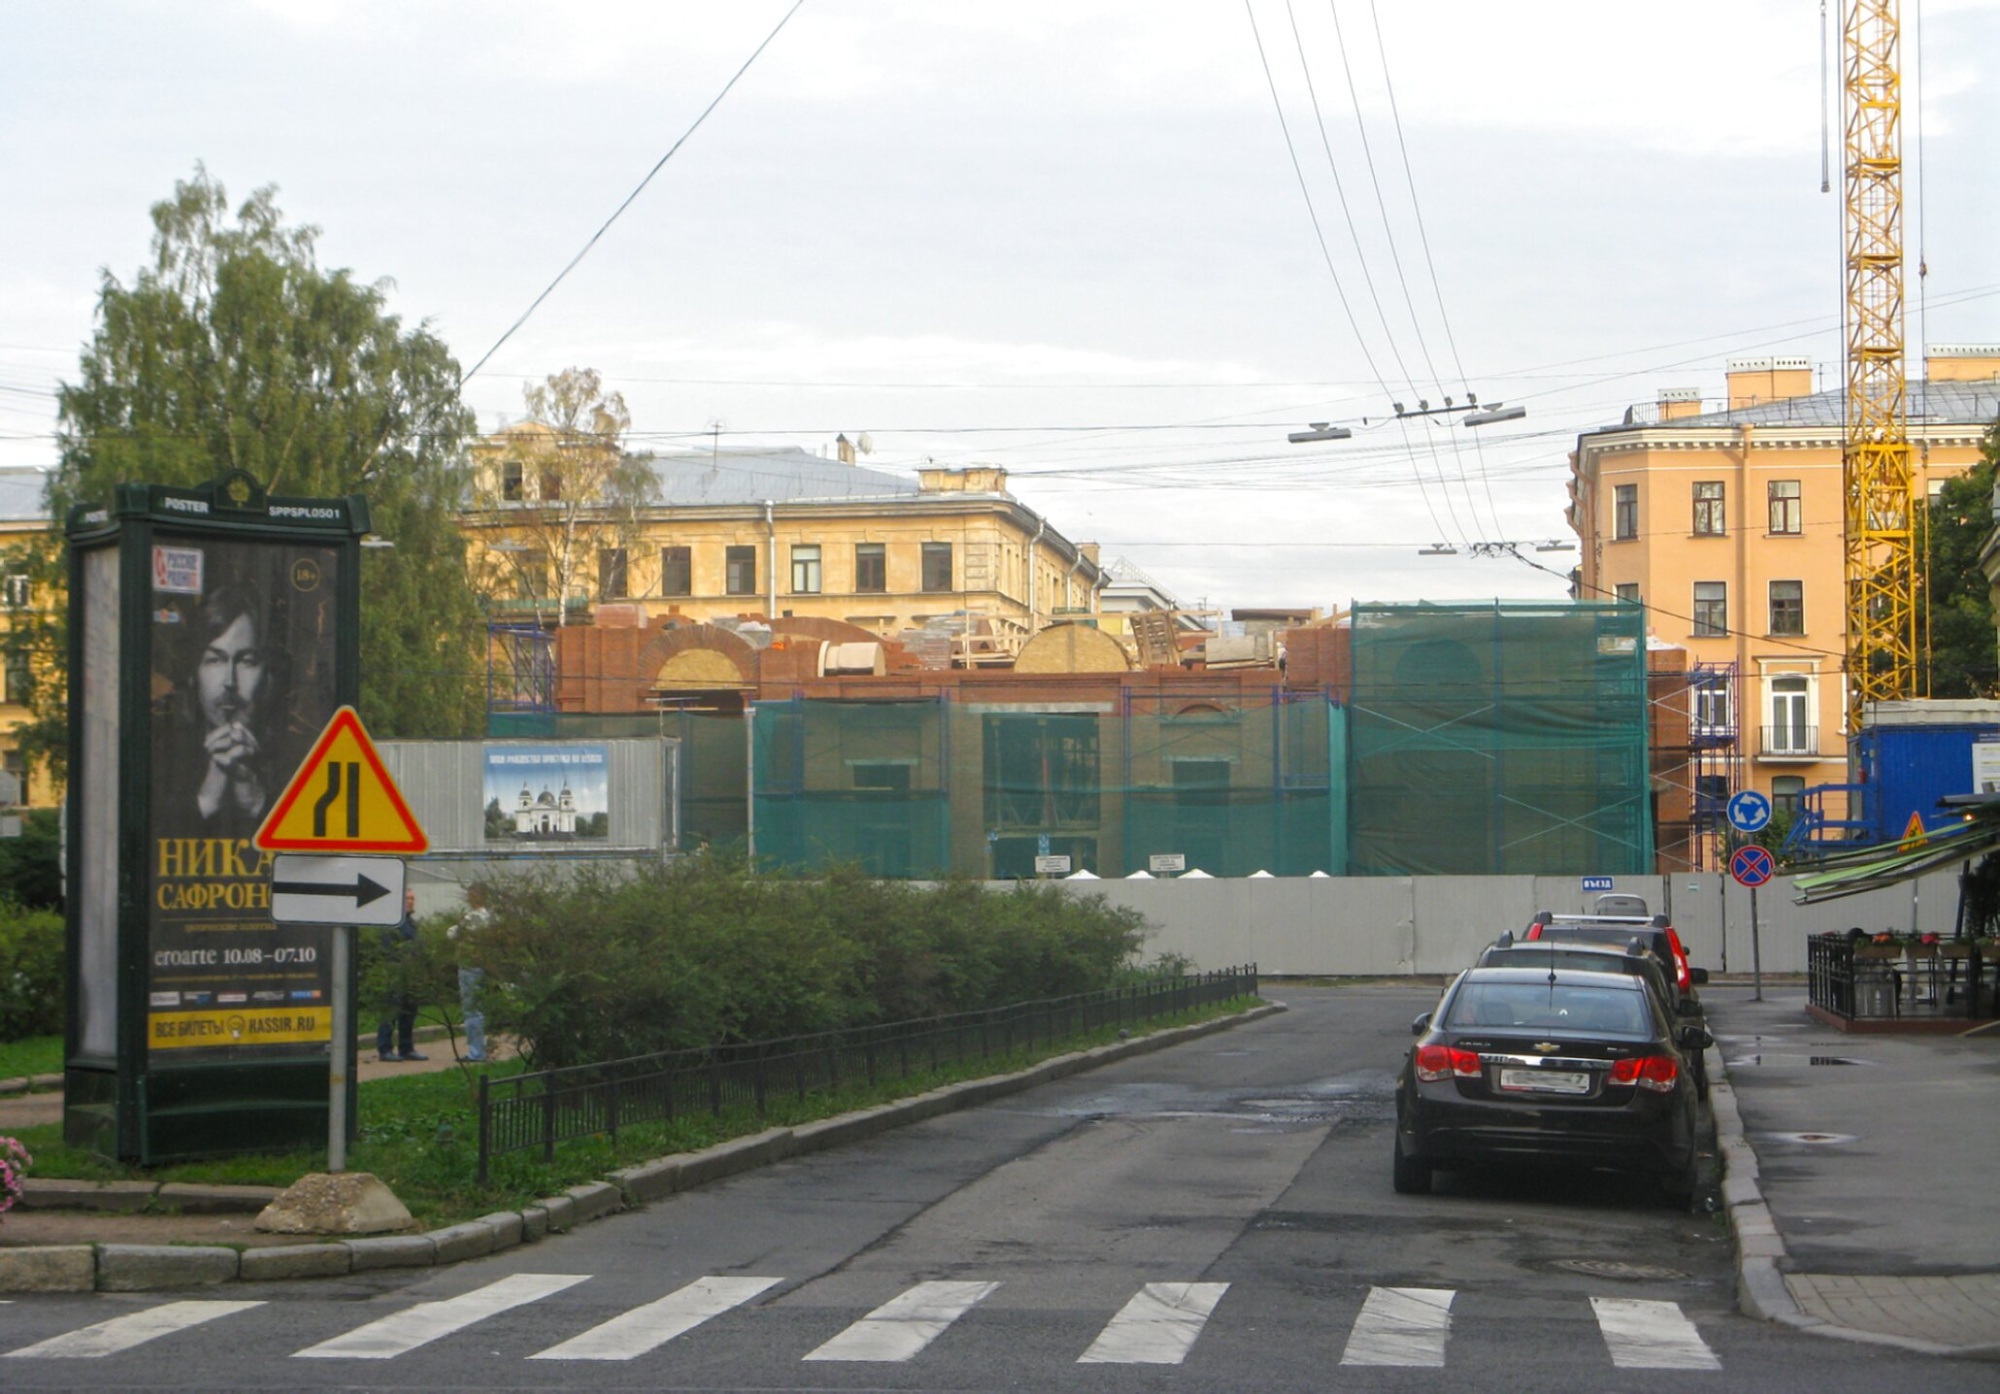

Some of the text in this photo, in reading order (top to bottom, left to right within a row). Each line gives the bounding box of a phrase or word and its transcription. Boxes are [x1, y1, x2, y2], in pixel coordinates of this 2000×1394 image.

[165, 497, 209, 513] POSTER
[157, 882, 271, 910] САФРОН
[154, 949, 218, 966] eroarte
[156, 1018, 225, 1038] ВСЕ БИЛЕТЫ
[249, 1016, 315, 1034] KASSIR.RU
